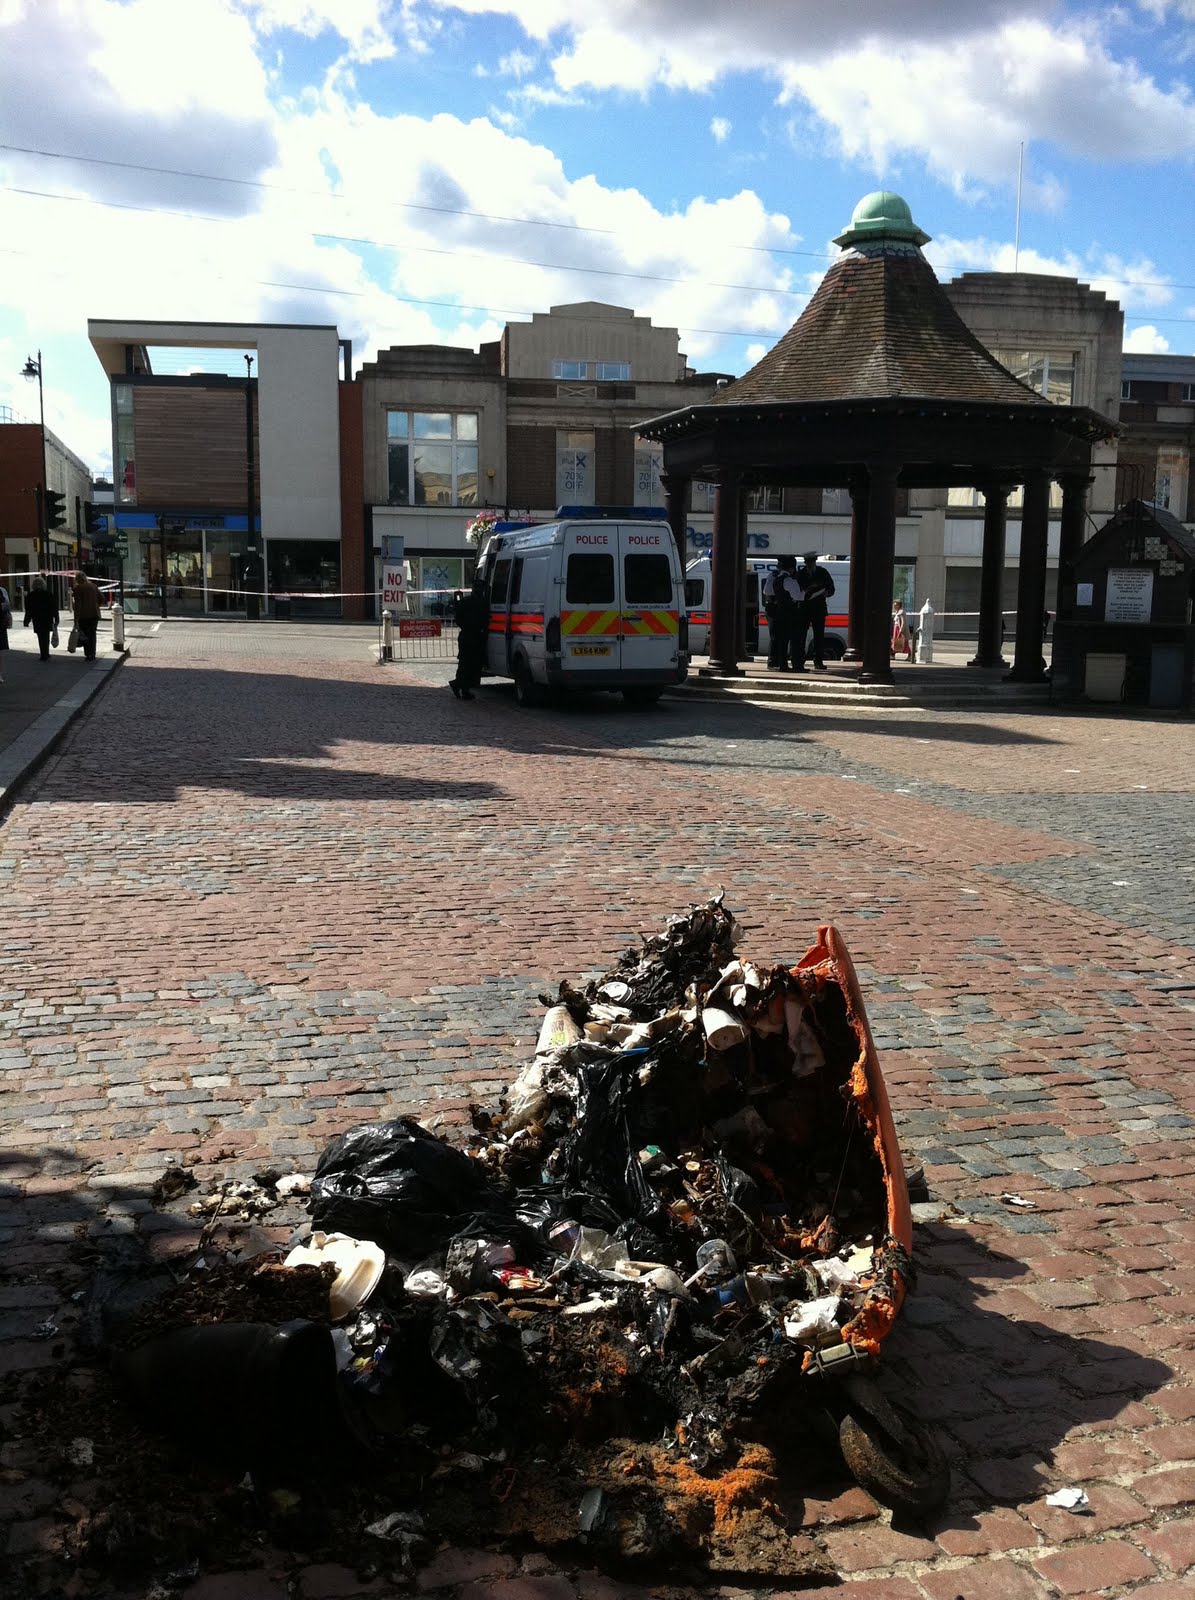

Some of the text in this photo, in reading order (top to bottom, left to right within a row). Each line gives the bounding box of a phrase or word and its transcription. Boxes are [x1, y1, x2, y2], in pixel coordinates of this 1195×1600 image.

[566, 471, 584, 480] 70%
[565, 480, 584, 490] OFF
[639, 481, 657, 490] OFF
[576, 535, 608, 545] POLICE
[628, 535, 660, 545] POLICE
[387, 573, 402, 586] NO
[384, 590, 405, 603] EXIT
